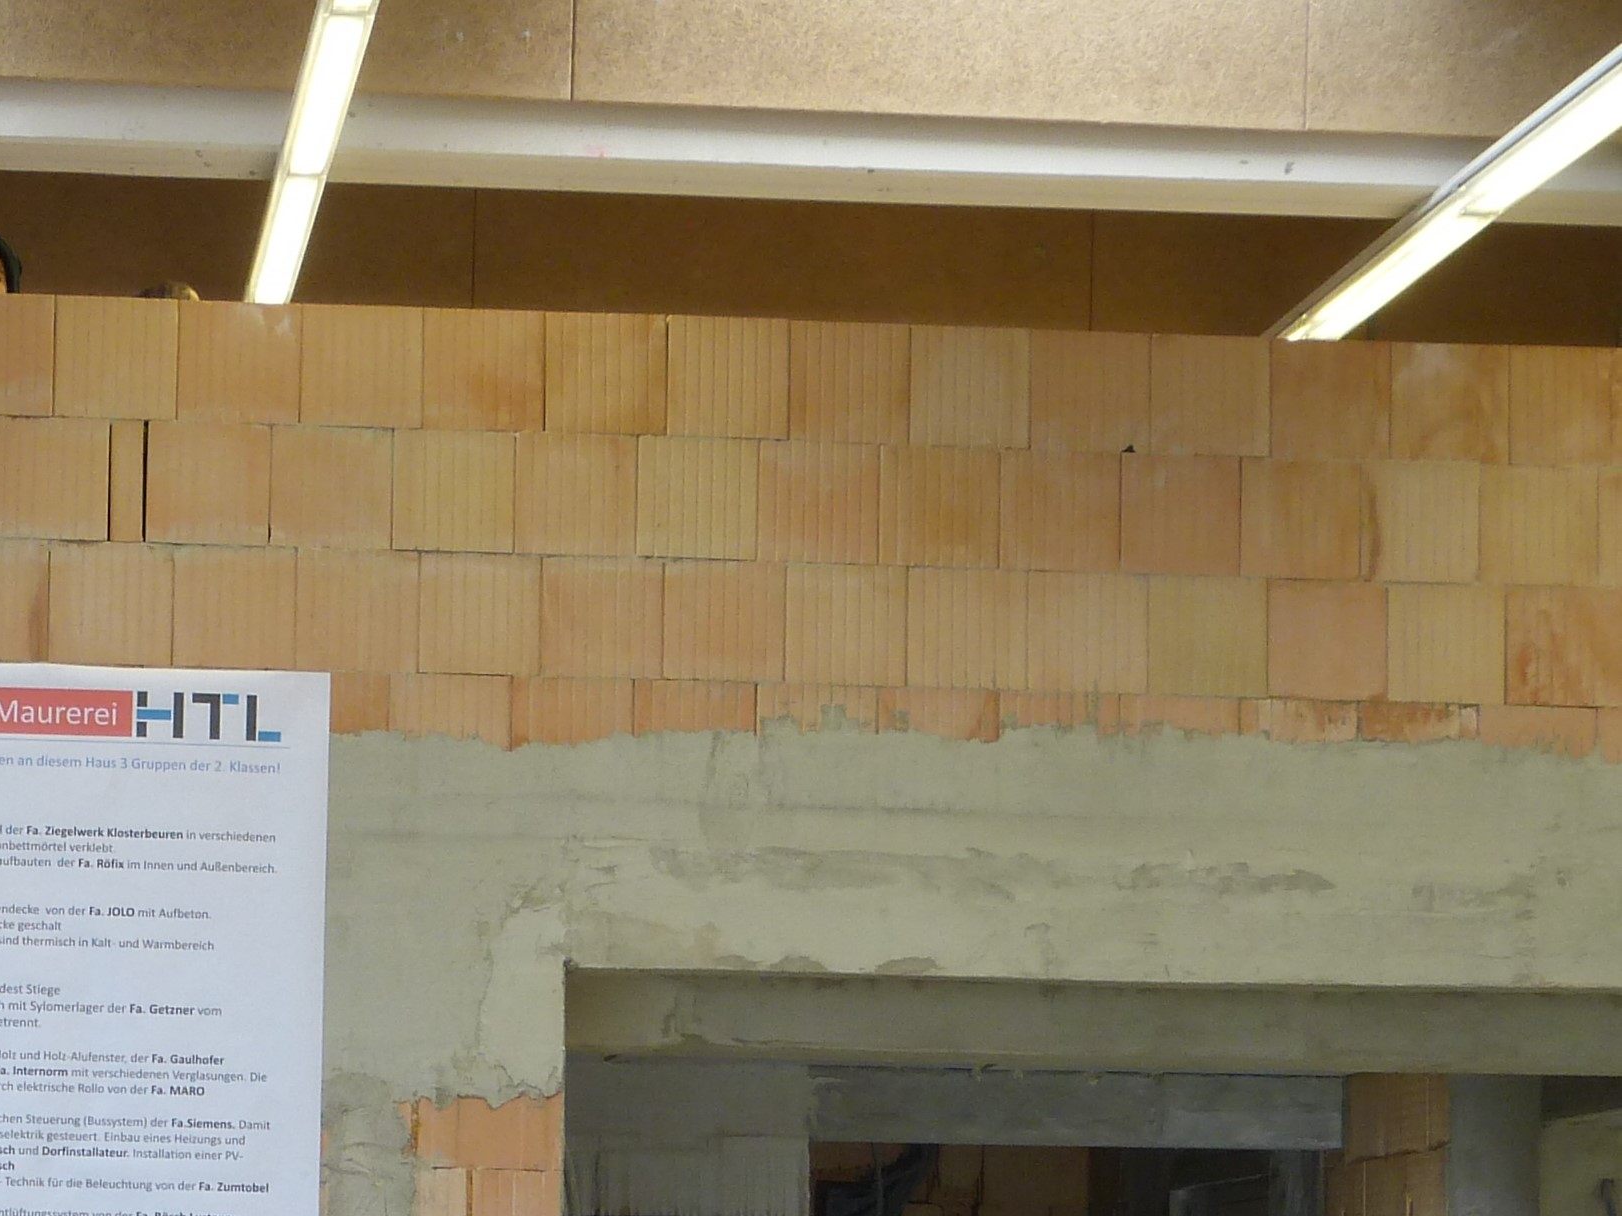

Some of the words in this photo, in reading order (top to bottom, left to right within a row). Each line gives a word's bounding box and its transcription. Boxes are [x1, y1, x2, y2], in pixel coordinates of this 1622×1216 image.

[136, 690, 282, 742] HTL
[36, 754, 81, 767] diesem
[85, 755, 116, 768] Haus
[131, 757, 186, 773] Gruppen
[189, 758, 210, 770] der
[229, 759, 280, 772] Klassen!
[5, 824, 23, 834] der
[44, 825, 103, 839] Ziegelwerk
[107, 827, 183, 839] Klosterbeuren
[186, 829, 196, 839] in
[199, 829, 275, 841] verschiedenen
[57, 857, 74, 867] der
[96, 858, 124, 868] Röfix
[127, 858, 140, 869] im
[143, 859, 173, 869] Innen
[176, 860, 197, 870] und
[67, 905, 85, 915] der
[107, 906, 134, 916] JOLO
[137, 906, 155, 917] mit
[17, 919, 61, 932] geschalt
[22, 935, 75, 946] thermisch
[78, 936, 88, 946] in
[118, 937, 139, 948] und
[142, 938, 214, 949] Warmbereich
[25, 983, 60, 997] Stiege
[8, 1000, 26, 1010] mit
[107, 1002, 126, 1013] der
[149, 1003, 194, 1015] Getzner
[19, 1049, 40, 1060] und
[130, 1052, 148, 1062] der
[12, 1065, 68, 1076] Internorm
[71, 1067, 88, 1076] mit
[92, 1067, 169, 1078] verschiedenen
[249, 1071, 267, 1081] Die
[16, 1080, 74, 1092] elektrische
[77, 1082, 104, 1093] Rollo
[129, 1083, 147, 1094] der
[169, 1084, 204, 1095] MARO
[25, 1113, 80, 1127] Steuerung
[83, 1115, 147, 1129] (Bussystem)
[150, 1117, 167, 1127] der
[238, 1119, 270, 1129] Damit
[104, 1131, 140, 1142] Einbau
[143, 1132, 171, 1142] eines
[224, 1134, 245, 1144] und
[18, 1144, 39, 1155] und
[132, 1147, 191, 1159] Installation
[194, 1149, 221, 1159] einer
[5, 1176, 44, 1186] Technik
[47, 1177, 62, 1187] für
[65, 1177, 82, 1187] die
[85, 1178, 152, 1192] Beleuchtung
[177, 1180, 195, 1190] der
[217, 1181, 268, 1192] Zumtobel
